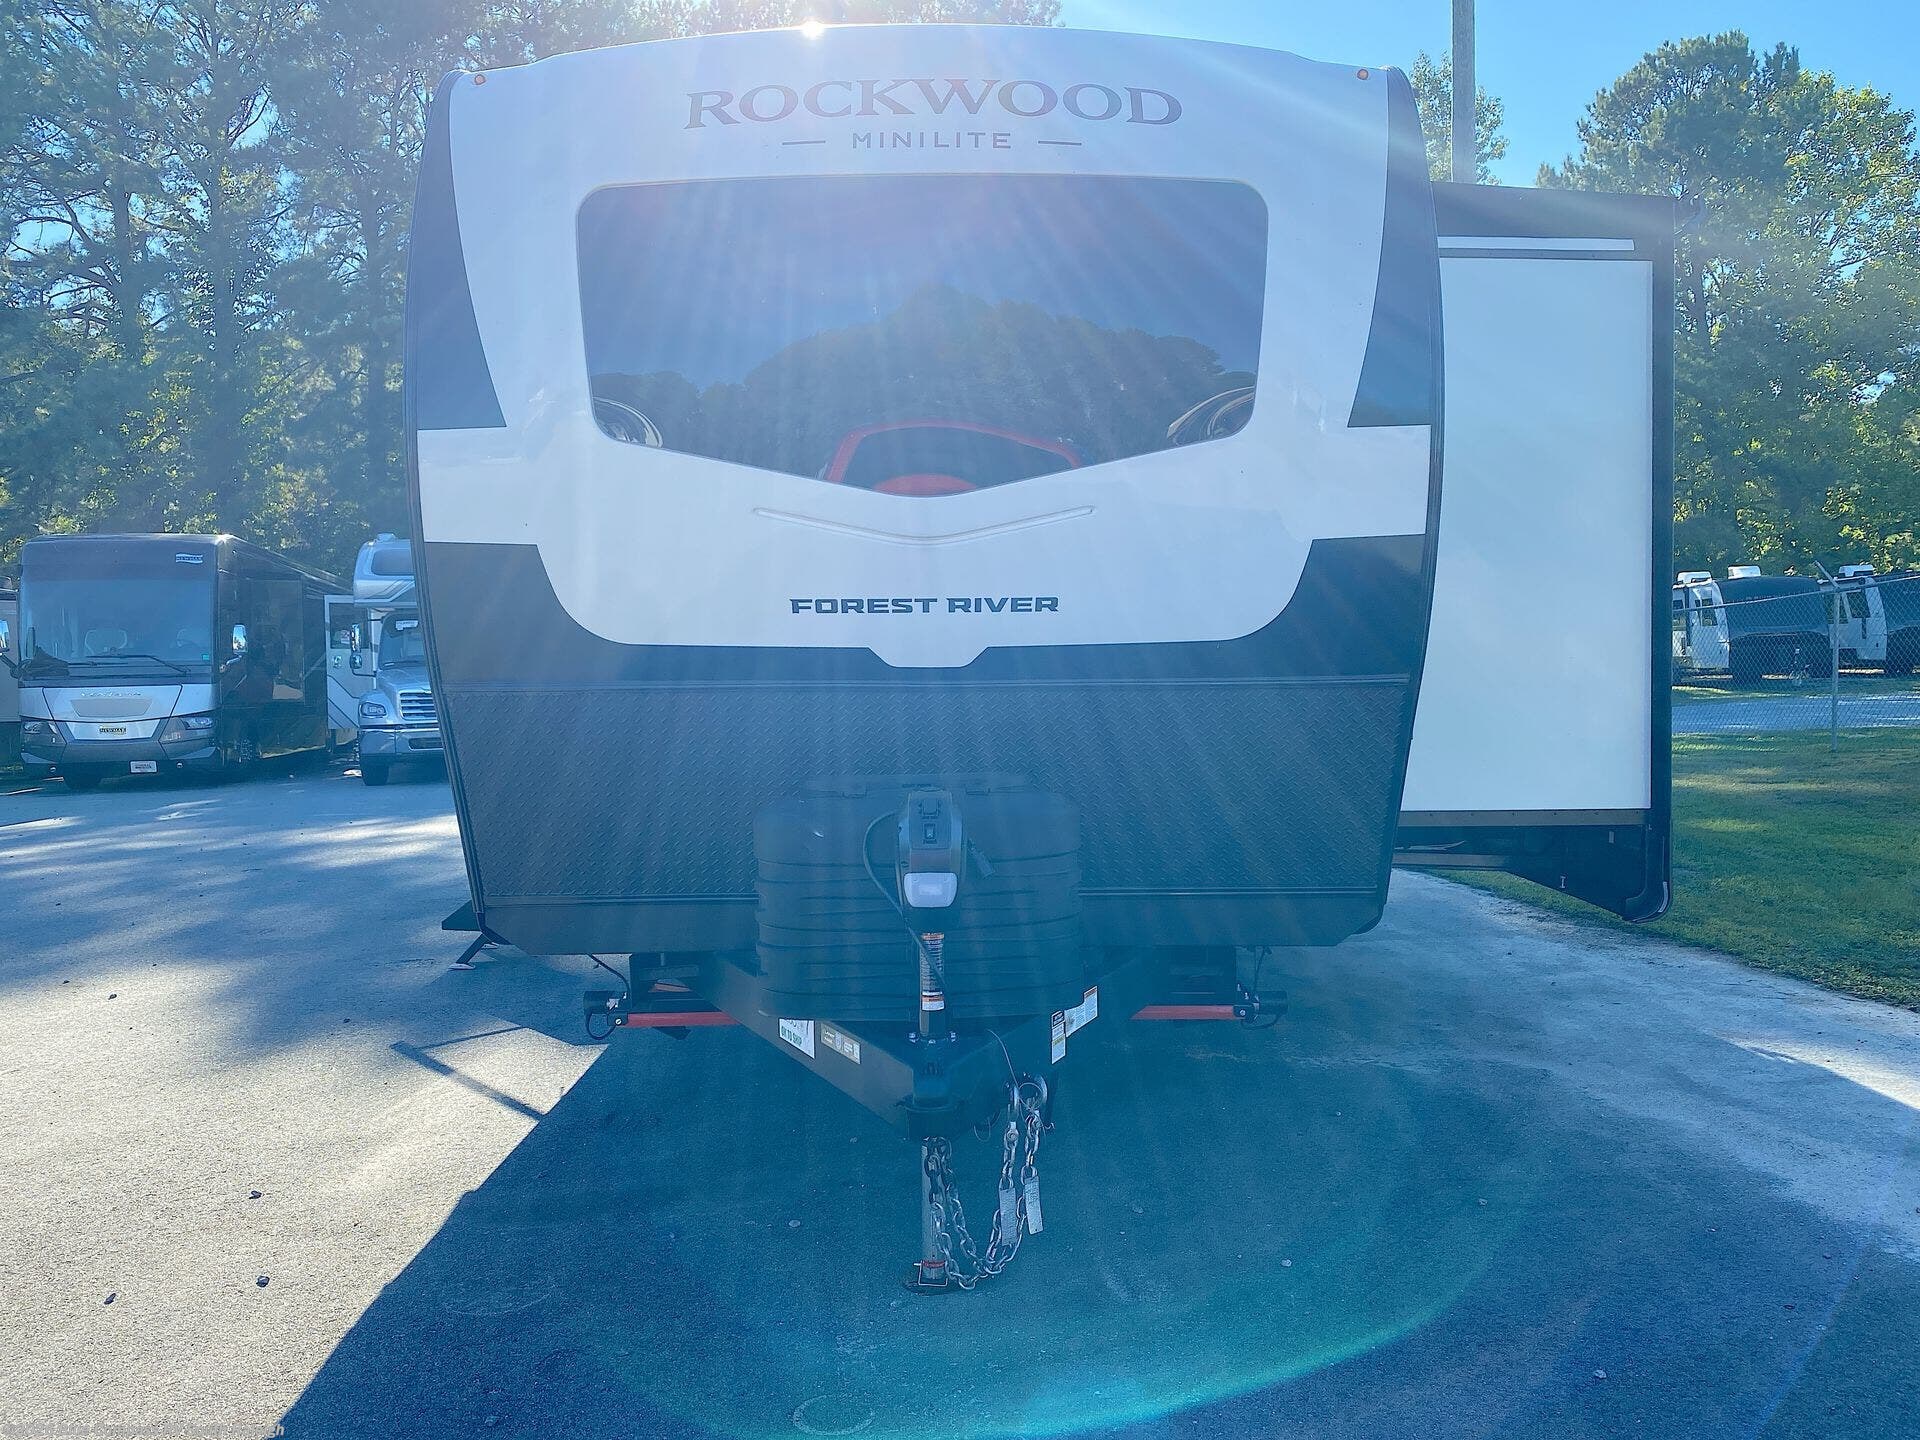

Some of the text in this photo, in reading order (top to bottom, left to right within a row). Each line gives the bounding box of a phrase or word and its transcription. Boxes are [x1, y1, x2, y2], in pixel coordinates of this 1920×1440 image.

[682, 77, 1183, 129] ROCKWOOD
[852, 131, 1012, 150] MINILITE
[789, 596, 1060, 614] FOREST RIVER
